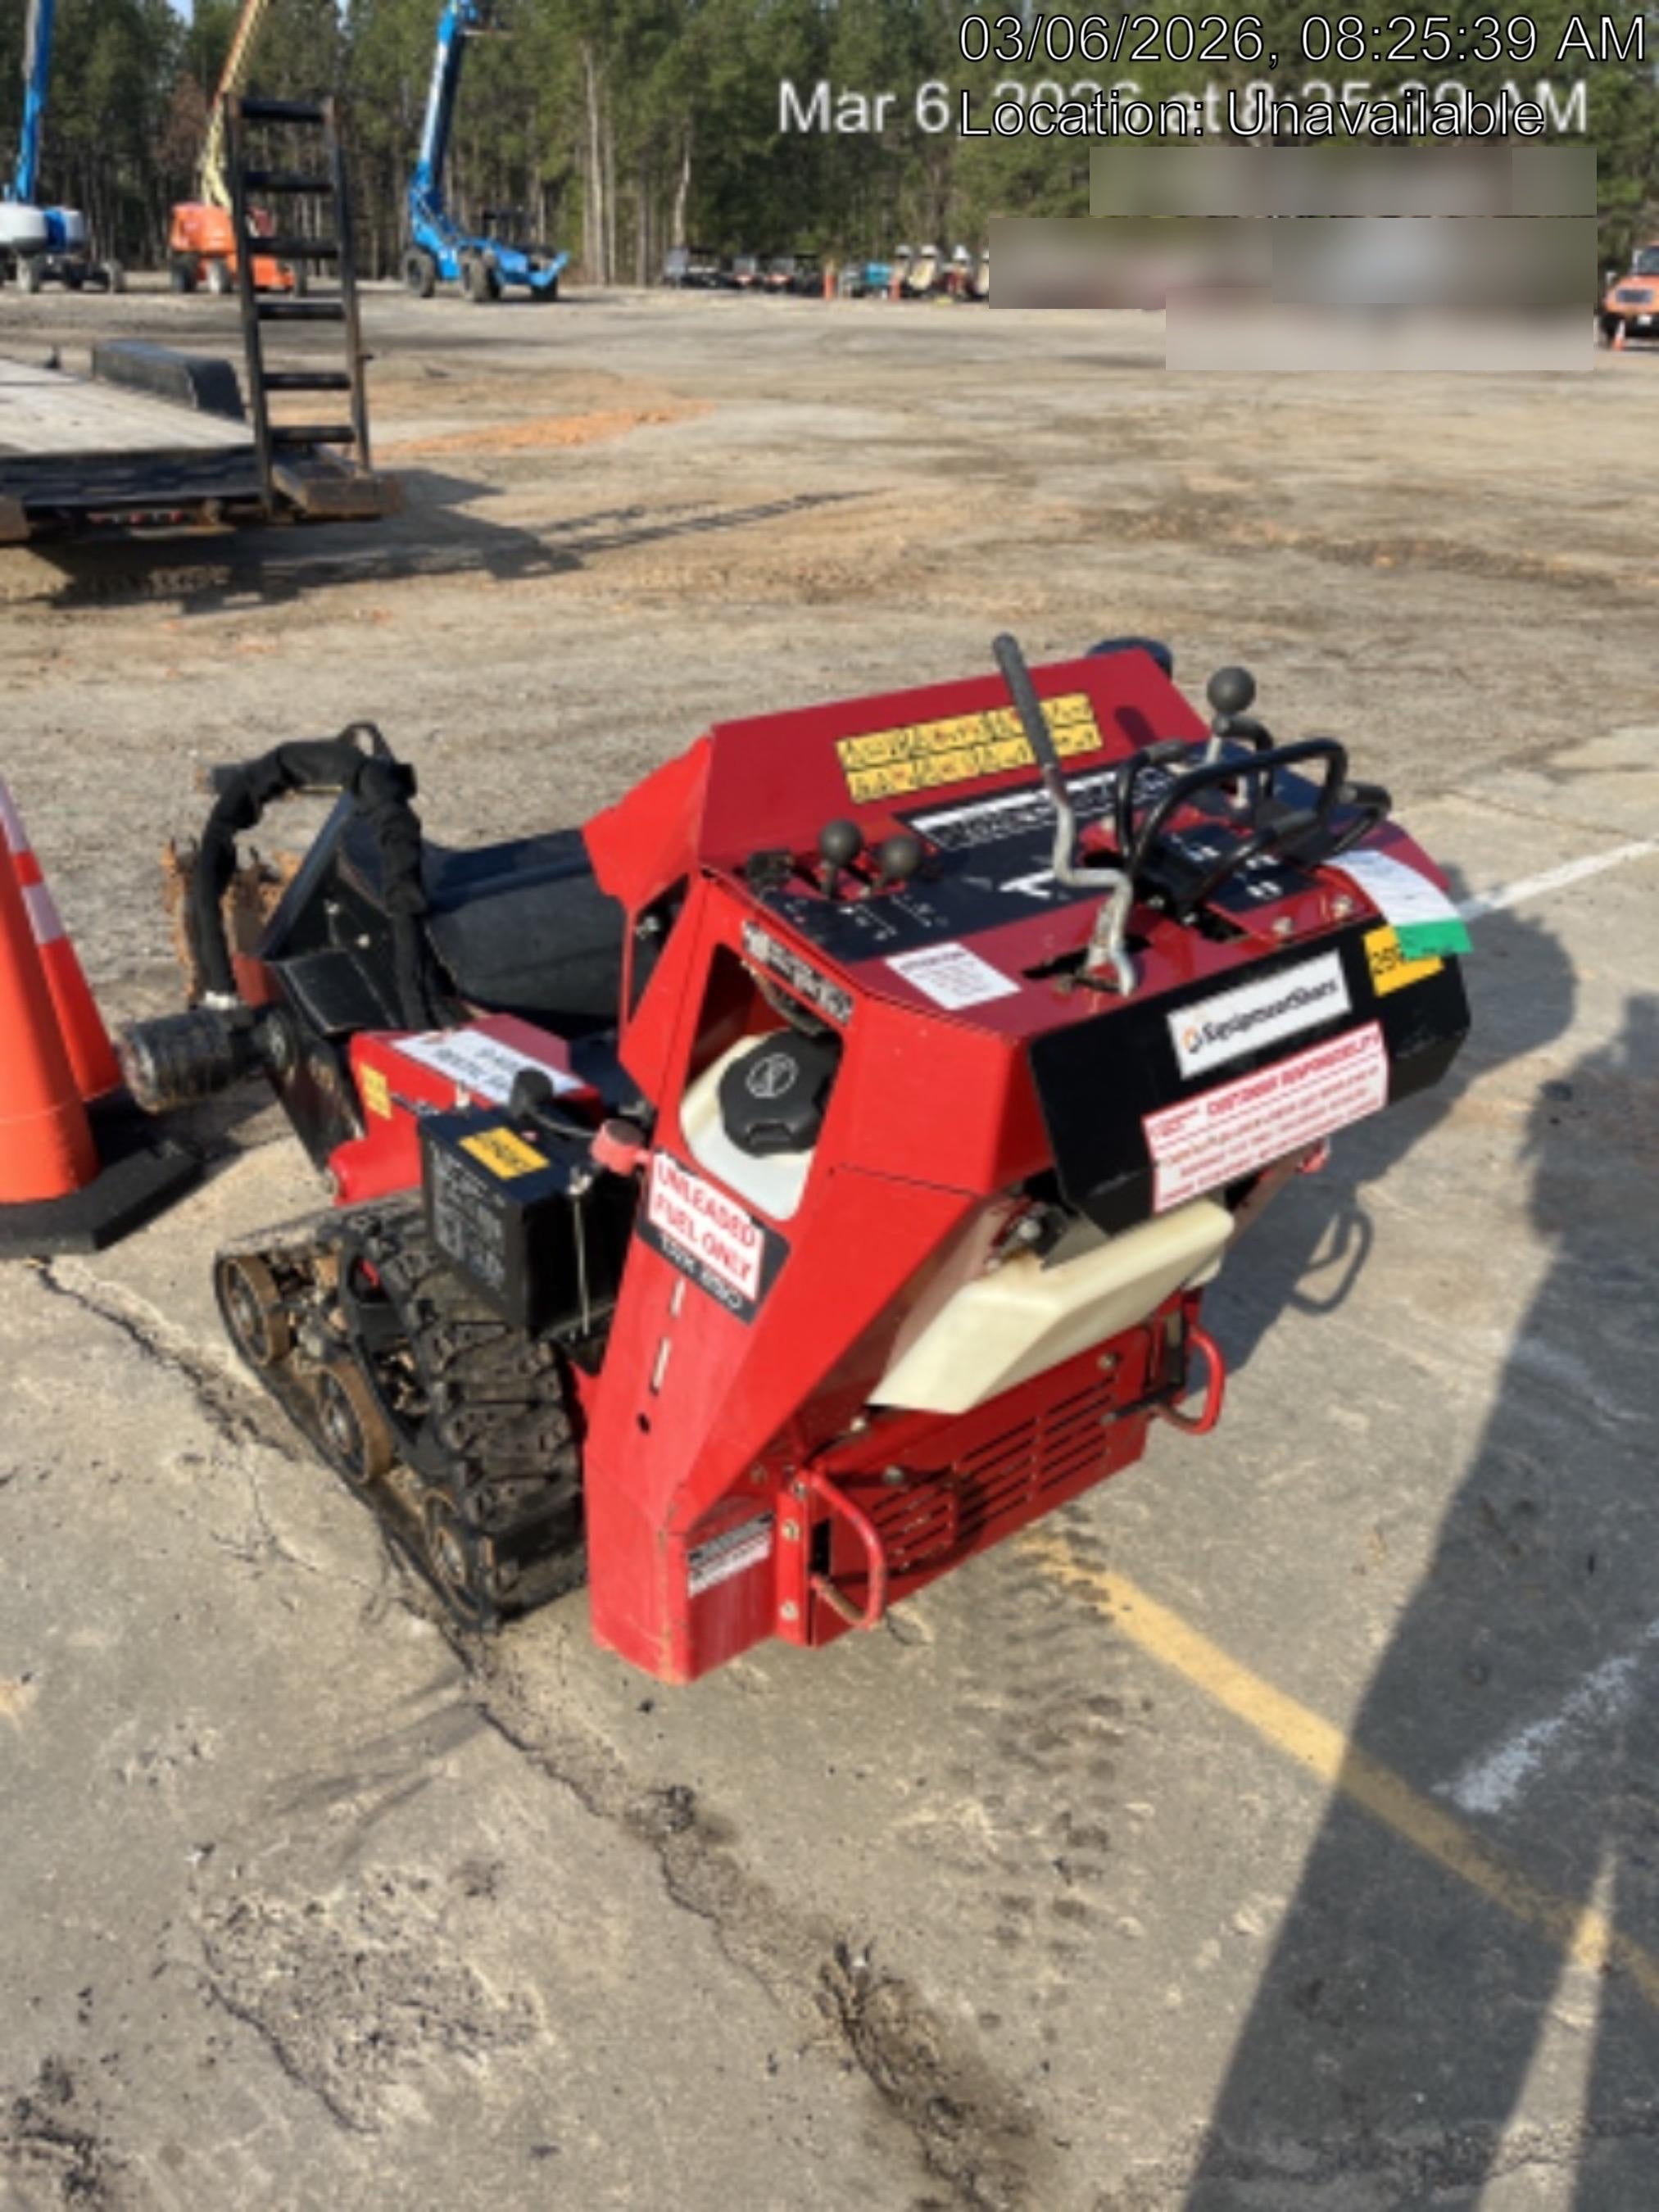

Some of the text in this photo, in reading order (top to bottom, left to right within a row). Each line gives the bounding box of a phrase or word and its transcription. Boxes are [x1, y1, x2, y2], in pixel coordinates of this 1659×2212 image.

[657, 1192, 699, 1243] FUEL
[702, 1232, 751, 1281] ONLY
[658, 1160, 755, 1248] UNLEADED
